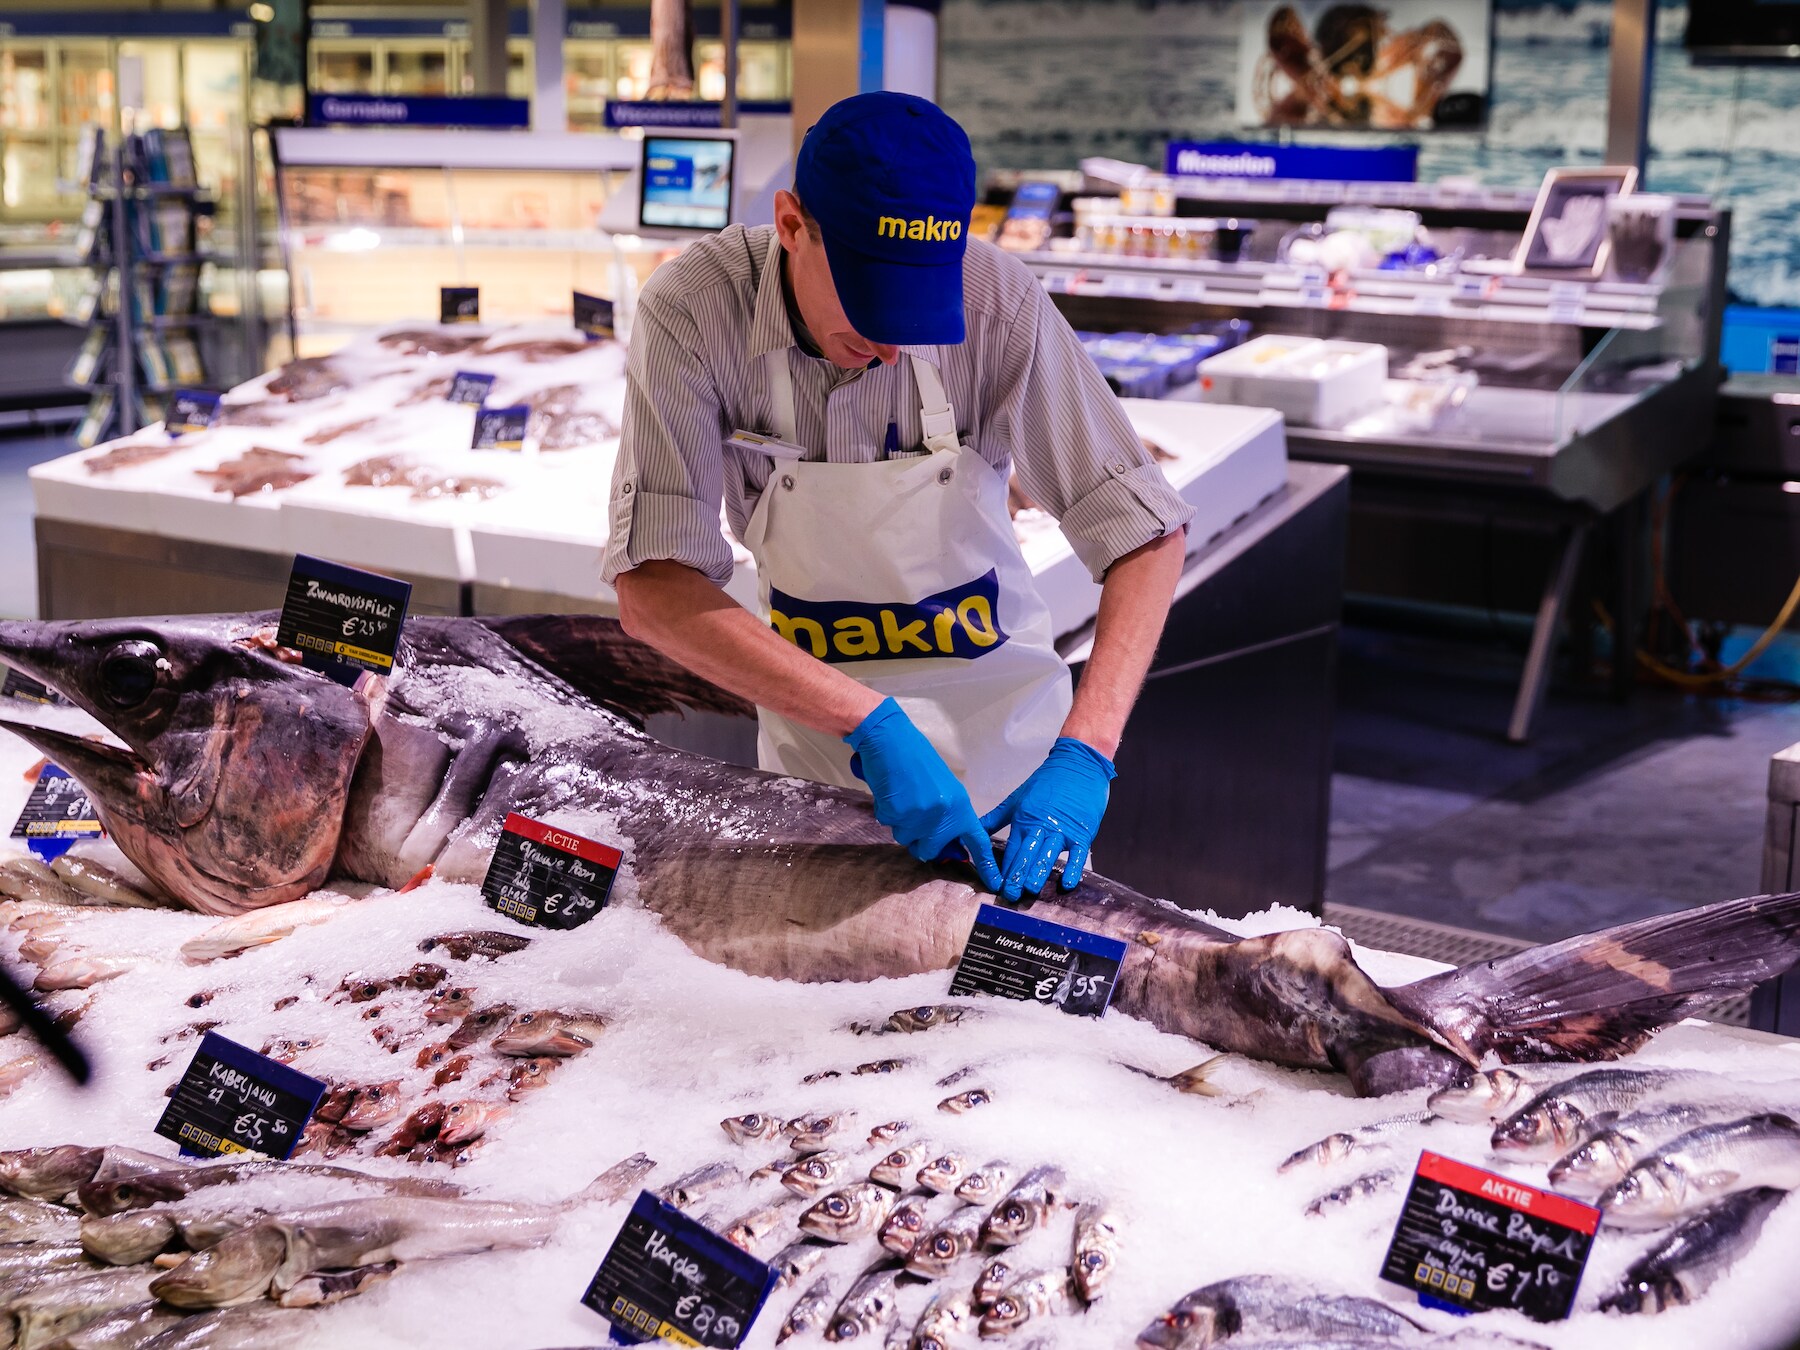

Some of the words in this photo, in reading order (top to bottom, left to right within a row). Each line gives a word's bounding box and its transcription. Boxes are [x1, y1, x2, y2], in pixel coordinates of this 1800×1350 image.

[878, 215, 961, 241] makro
[770, 595, 998, 658] makro
[543, 831, 580, 851] ACTIE
[995, 935, 1023, 951] Horse
[1025, 944, 1070, 963] makreel
[1481, 1178, 1532, 1208] AKTIE
